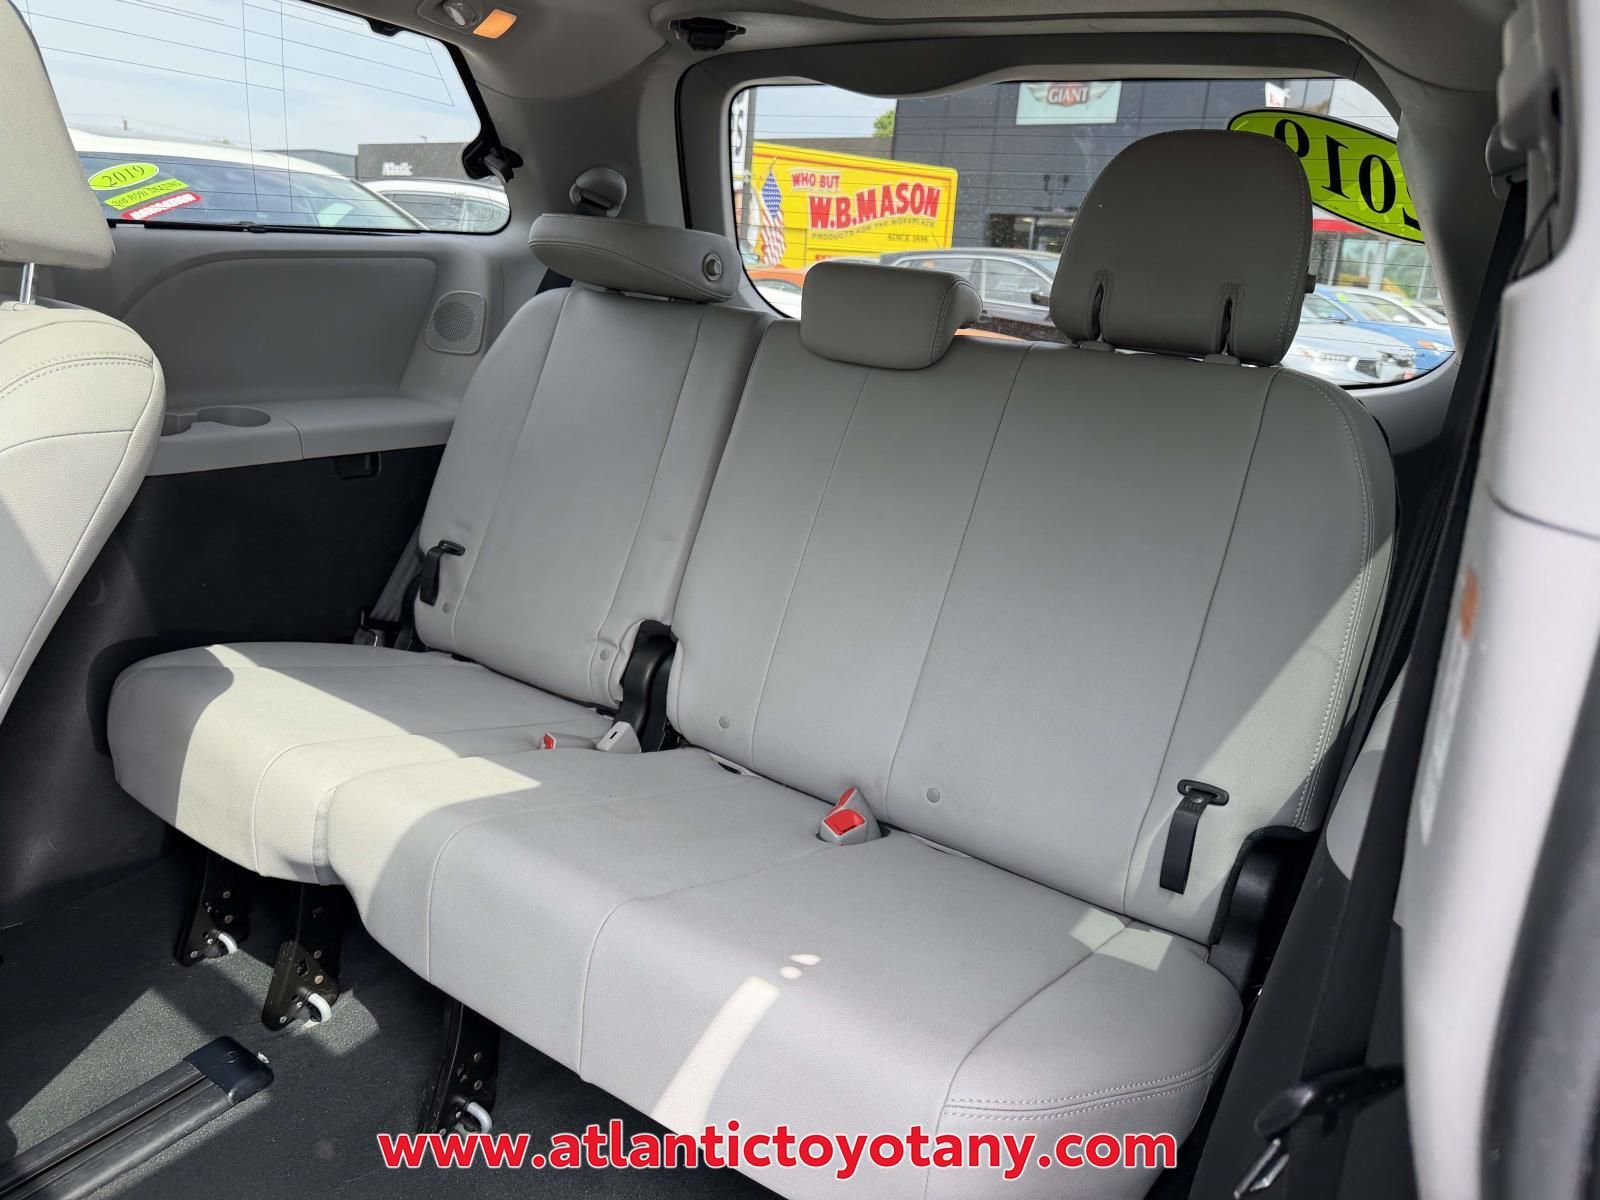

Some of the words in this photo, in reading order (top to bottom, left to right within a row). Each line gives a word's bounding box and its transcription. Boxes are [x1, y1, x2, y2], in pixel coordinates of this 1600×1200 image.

[1047, 87, 1089, 103] GIANT
[101, 165, 145, 187] 2019
[792, 173, 816, 187] WHO
[819, 174, 840, 189] BUT
